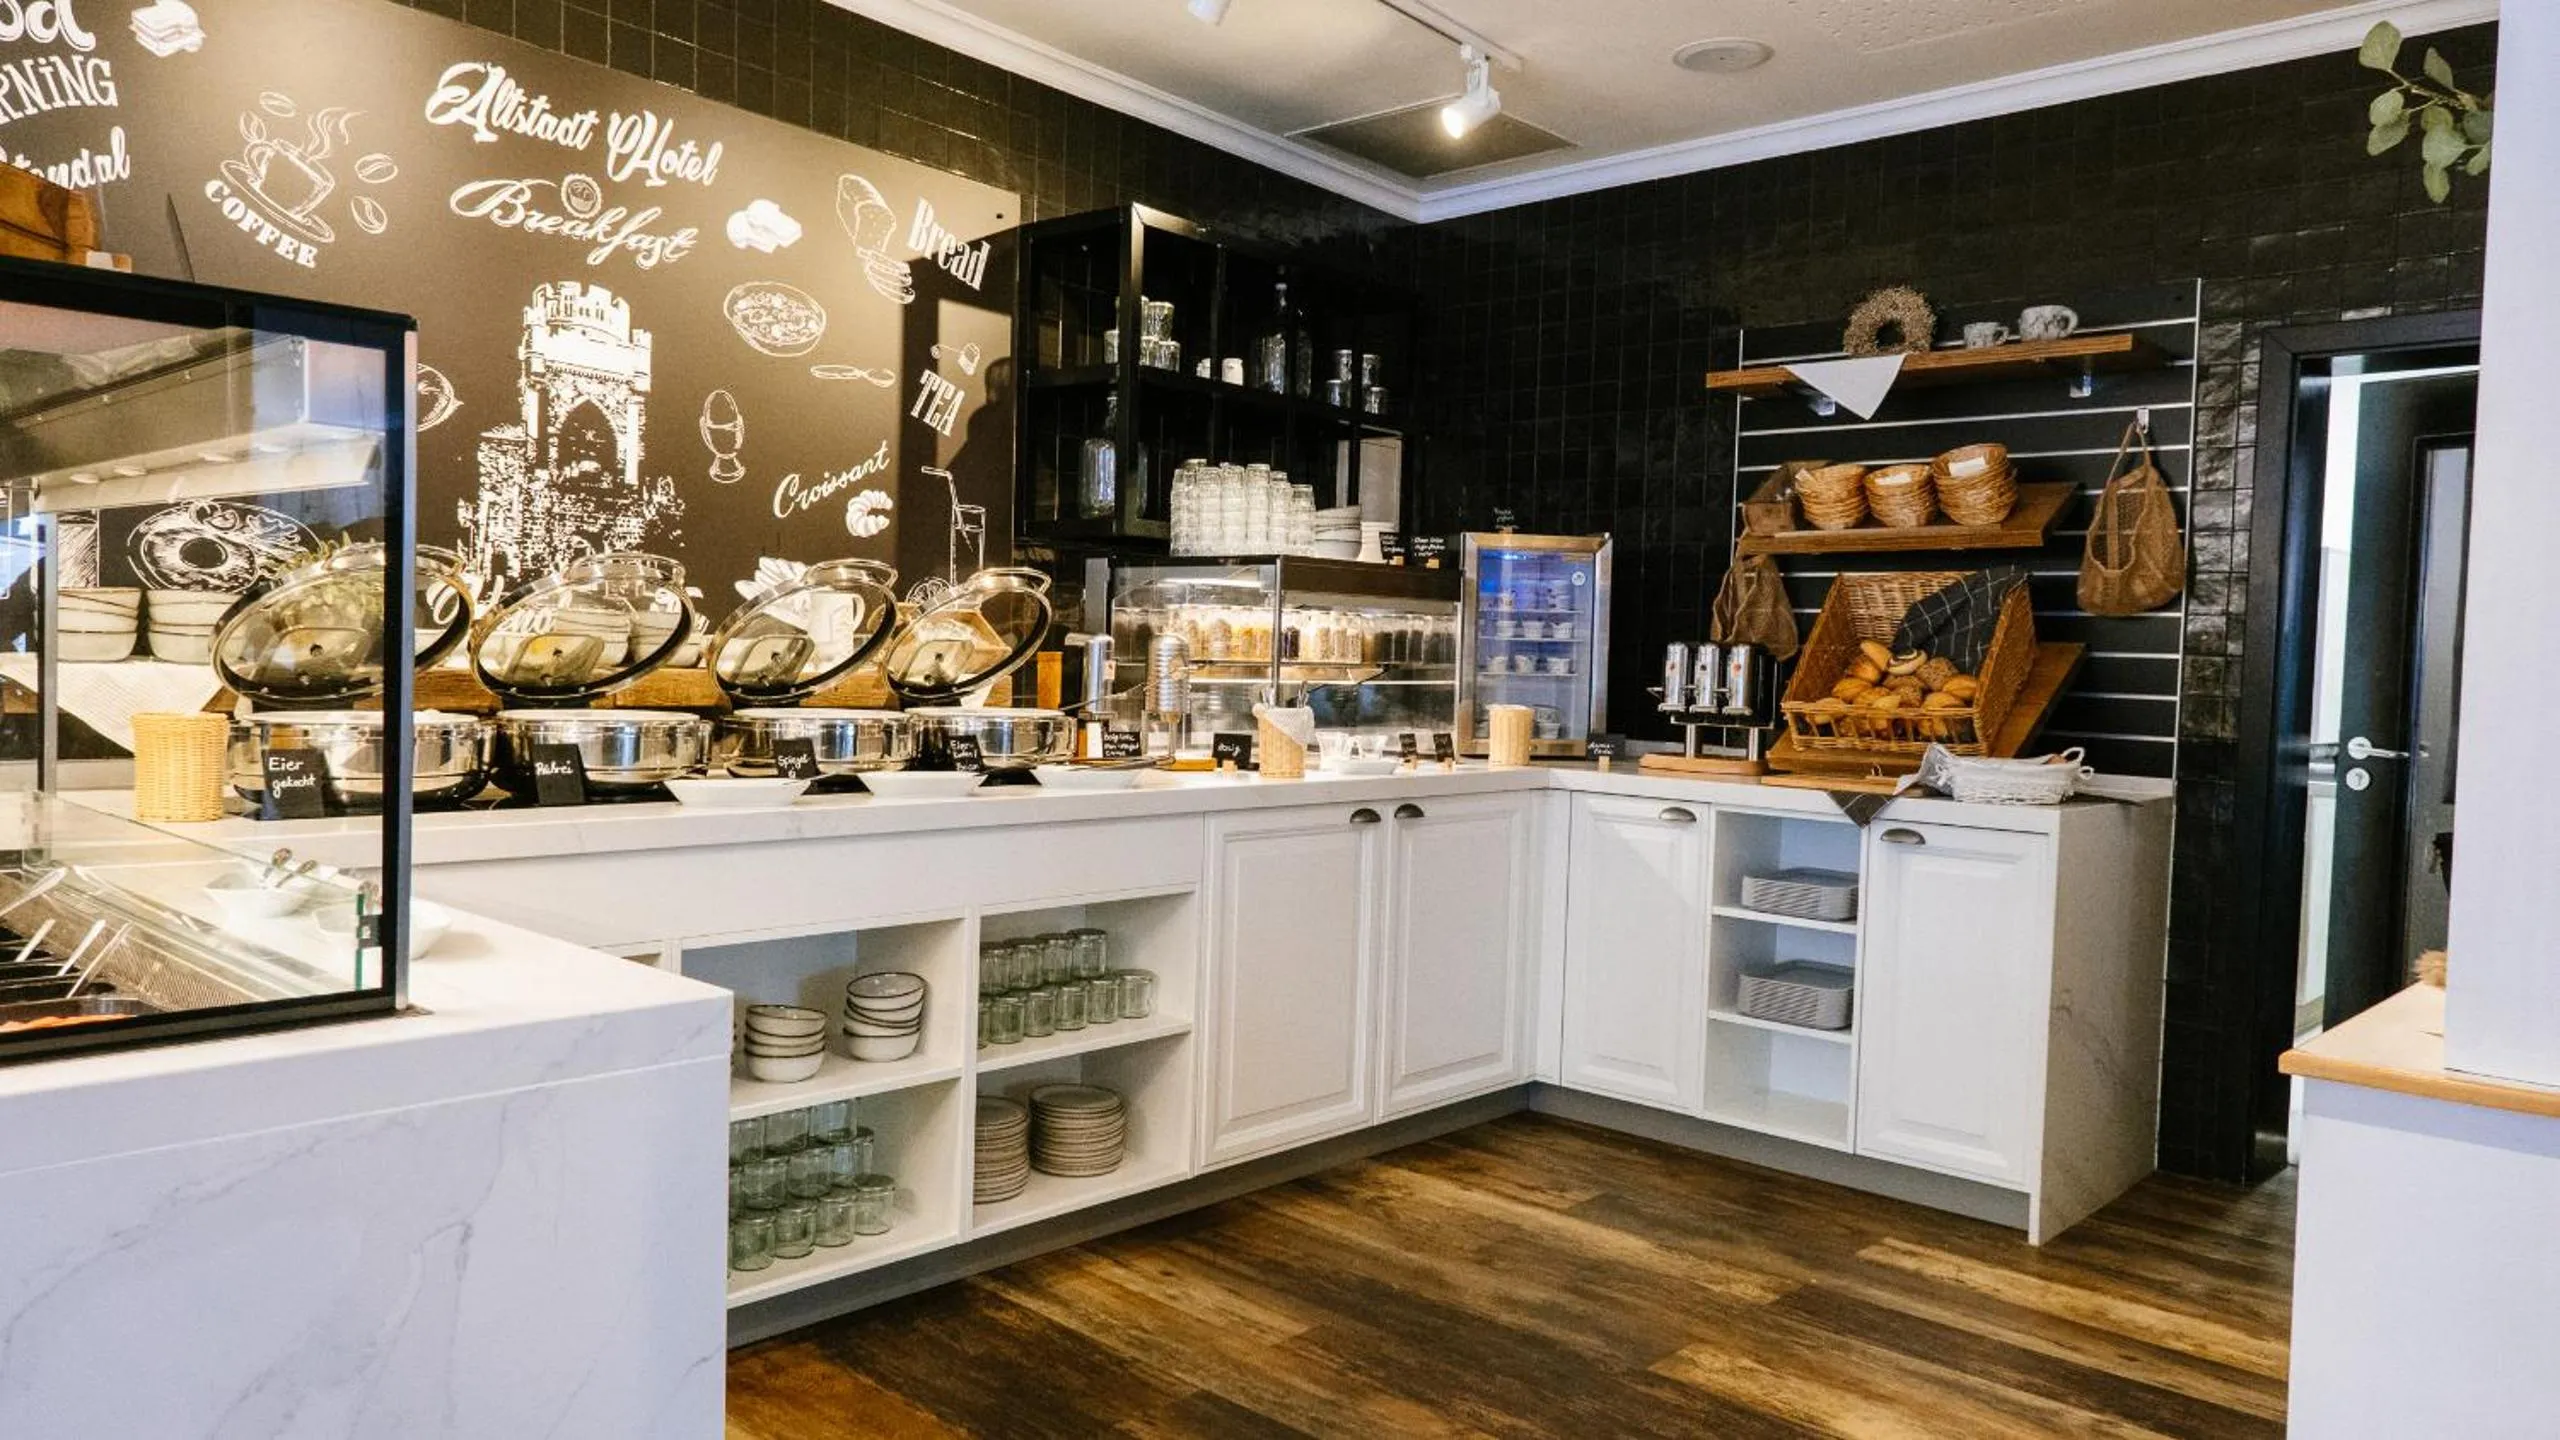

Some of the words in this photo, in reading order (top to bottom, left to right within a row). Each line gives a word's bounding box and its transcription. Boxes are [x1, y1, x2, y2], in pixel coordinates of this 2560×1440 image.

[425, 61, 600, 150] Altstadt
[607, 110, 723, 186] Hotel
[204, 179, 318, 269] COFFEE
[450, 178, 698, 269] Breakfast
[906, 196, 992, 291] Bread
[910, 369, 965, 438] TEA
[773, 439, 890, 519] Croissant
[268, 756, 304, 771] Eier
